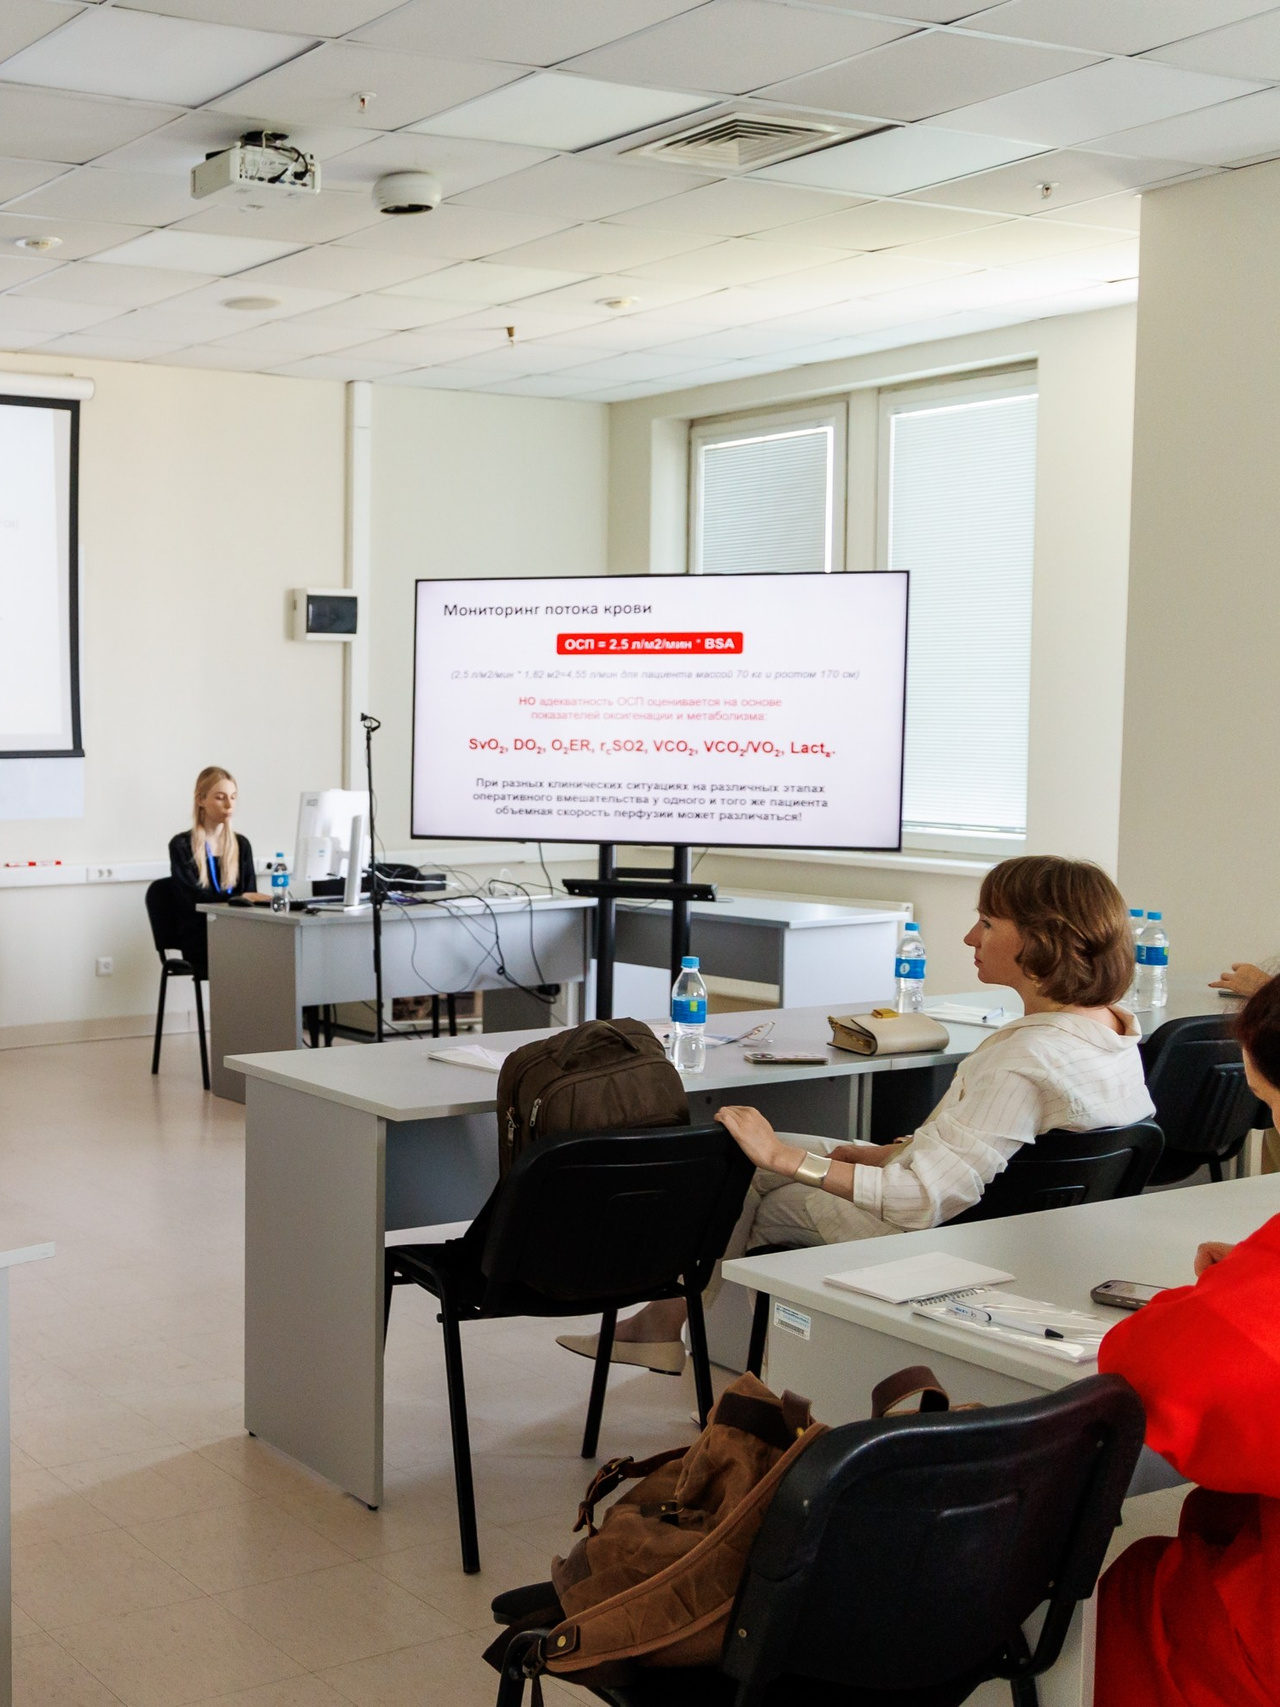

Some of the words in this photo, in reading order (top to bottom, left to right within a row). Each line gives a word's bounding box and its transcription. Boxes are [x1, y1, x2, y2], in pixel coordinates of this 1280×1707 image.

[443, 604, 540, 618] Мониторинг
[546, 604, 598, 615] потока
[604, 605, 652, 617] крови
[565, 639, 594, 650] ОСП
[631, 638, 692, 650] л/м2/мин
[705, 638, 734, 649] BSA
[621, 670, 638, 679] для
[641, 671, 693, 679] пациента
[696, 670, 733, 679] массой
[737, 670, 749, 678] 70
[774, 672, 816, 681] ростом
[821, 670, 839, 679] 170
[518, 696, 536, 706] НО
[540, 698, 613, 708] адекватность
[617, 696, 643, 707] ОСП
[647, 698, 720, 708] оценивается
[724, 698, 737, 706] на
[742, 698, 782, 707] основе
[531, 710, 600, 721] показателей
[603, 712, 674, 721] оксигенации
[476, 777, 498, 788] При
[502, 780, 544, 789] разных
[548, 780, 622, 789] клинических
[626, 782, 688, 791] ситуациях
[693, 783, 707, 791] на
[711, 783, 779, 793] различных
[784, 784, 825, 793] этапах
[473, 792, 553, 802] оперативного
[557, 794, 649, 804] вмешательства
[664, 797, 705, 805] одного
[751, 798, 766, 806] же
[770, 799, 828, 808] пациента
[496, 806, 553, 816] объемная
[557, 808, 610, 818] скорость
[614, 808, 674, 819] перфузии
[678, 810, 715, 819] может
[719, 812, 802, 822] различаться!
